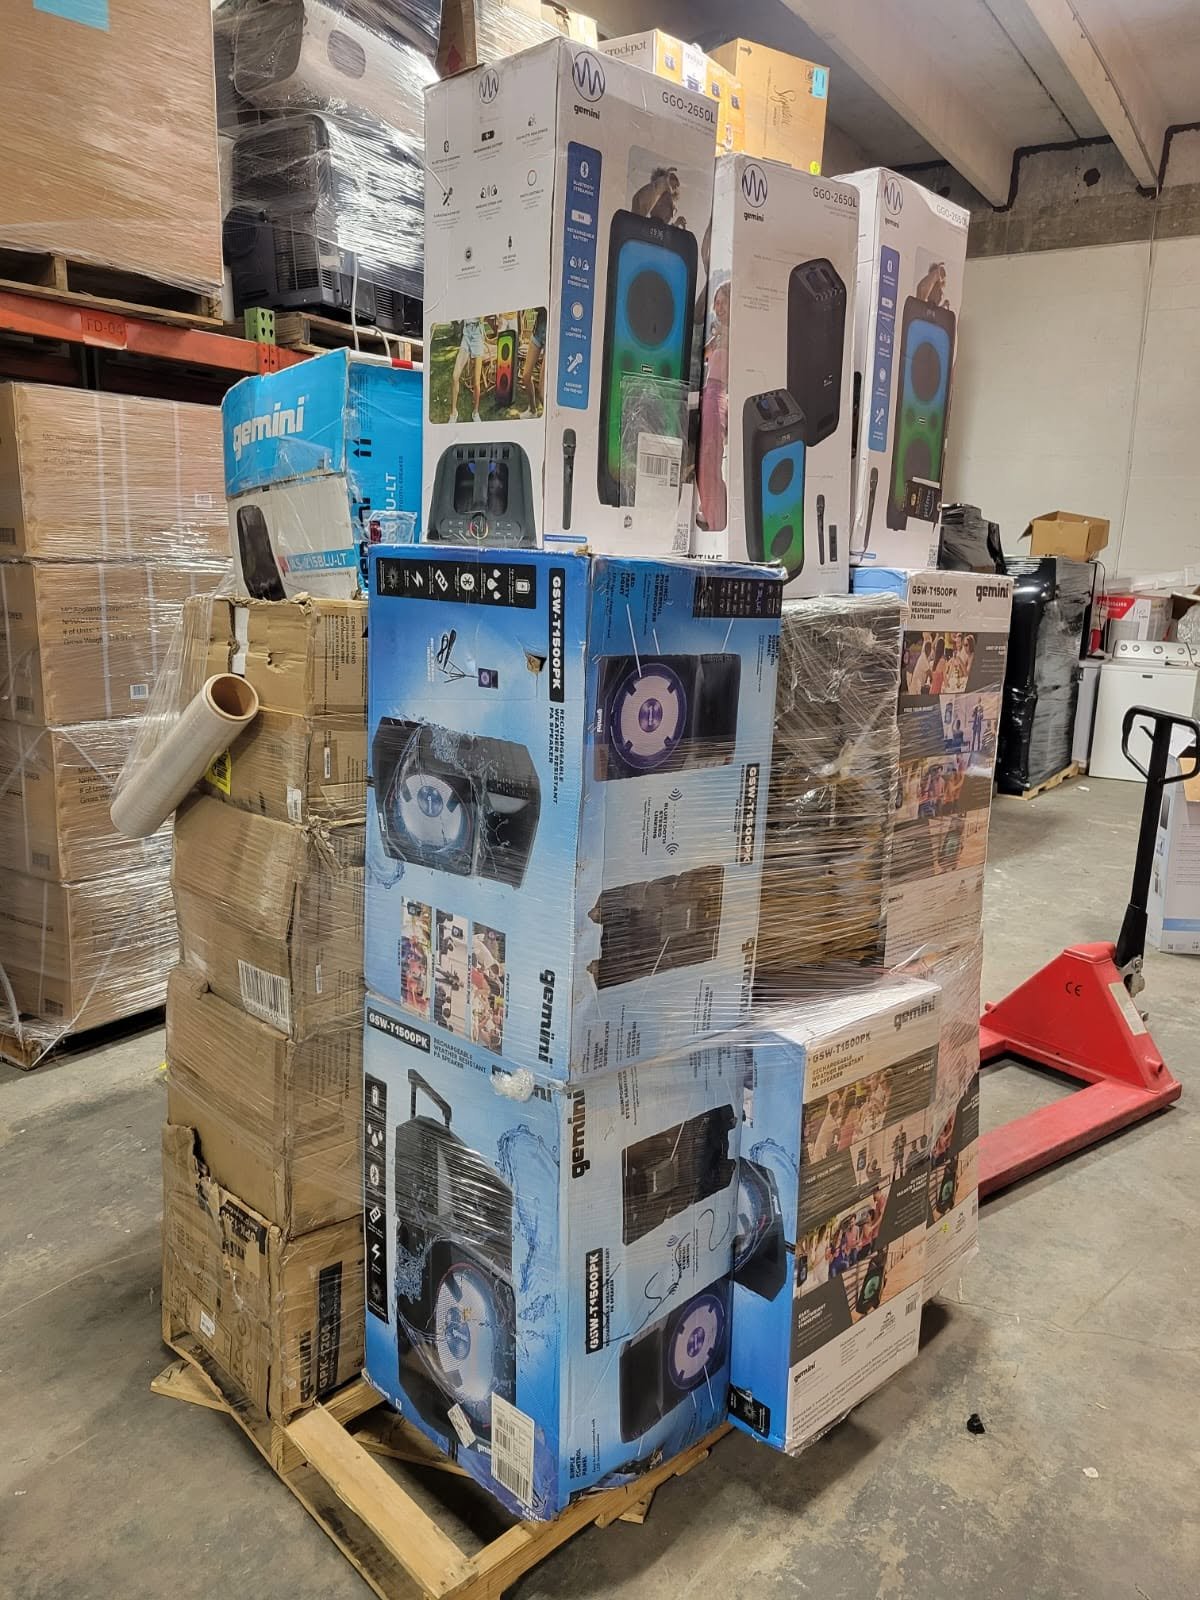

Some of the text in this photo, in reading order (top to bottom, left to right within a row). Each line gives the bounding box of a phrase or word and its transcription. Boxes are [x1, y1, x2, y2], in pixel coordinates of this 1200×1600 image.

[573, 103, 601, 121] gemini
[661, 91, 716, 124] GGO-2650L
[743, 211, 765, 223] gemini
[812, 187, 858, 208] GGO-2650L
[233, 396, 305, 462] gemini
[651, 574, 660, 623] SUBWOOFER
[657, 574, 665, 616] POWERFUL
[911, 583, 1009, 602] GSW-T1500PK gemini
[552, 576, 561, 690] GSW-T1500PK
[549, 707, 554, 719] PA
[743, 766, 758, 864] GSW-T1500PK
[1065, 981, 1083, 997] CE
[368, 1013, 429, 1049] GSW-T1500PK
[538, 969, 556, 1065] gemini
[812, 996, 937, 1063] GSW-T1500PK gemini
[433, 1038, 473, 1060] RECHARGEABLE
[433, 1045, 487, 1074] WEATHER RESISTANT
[566, 1088, 591, 1179] gemini
[589, 1252, 599, 1350] GSW-T1500PK
[299, 1330, 314, 1404] gemini
[318, 1324, 331, 1388] GPK-1200
[794, 1360, 817, 1383] gemini
